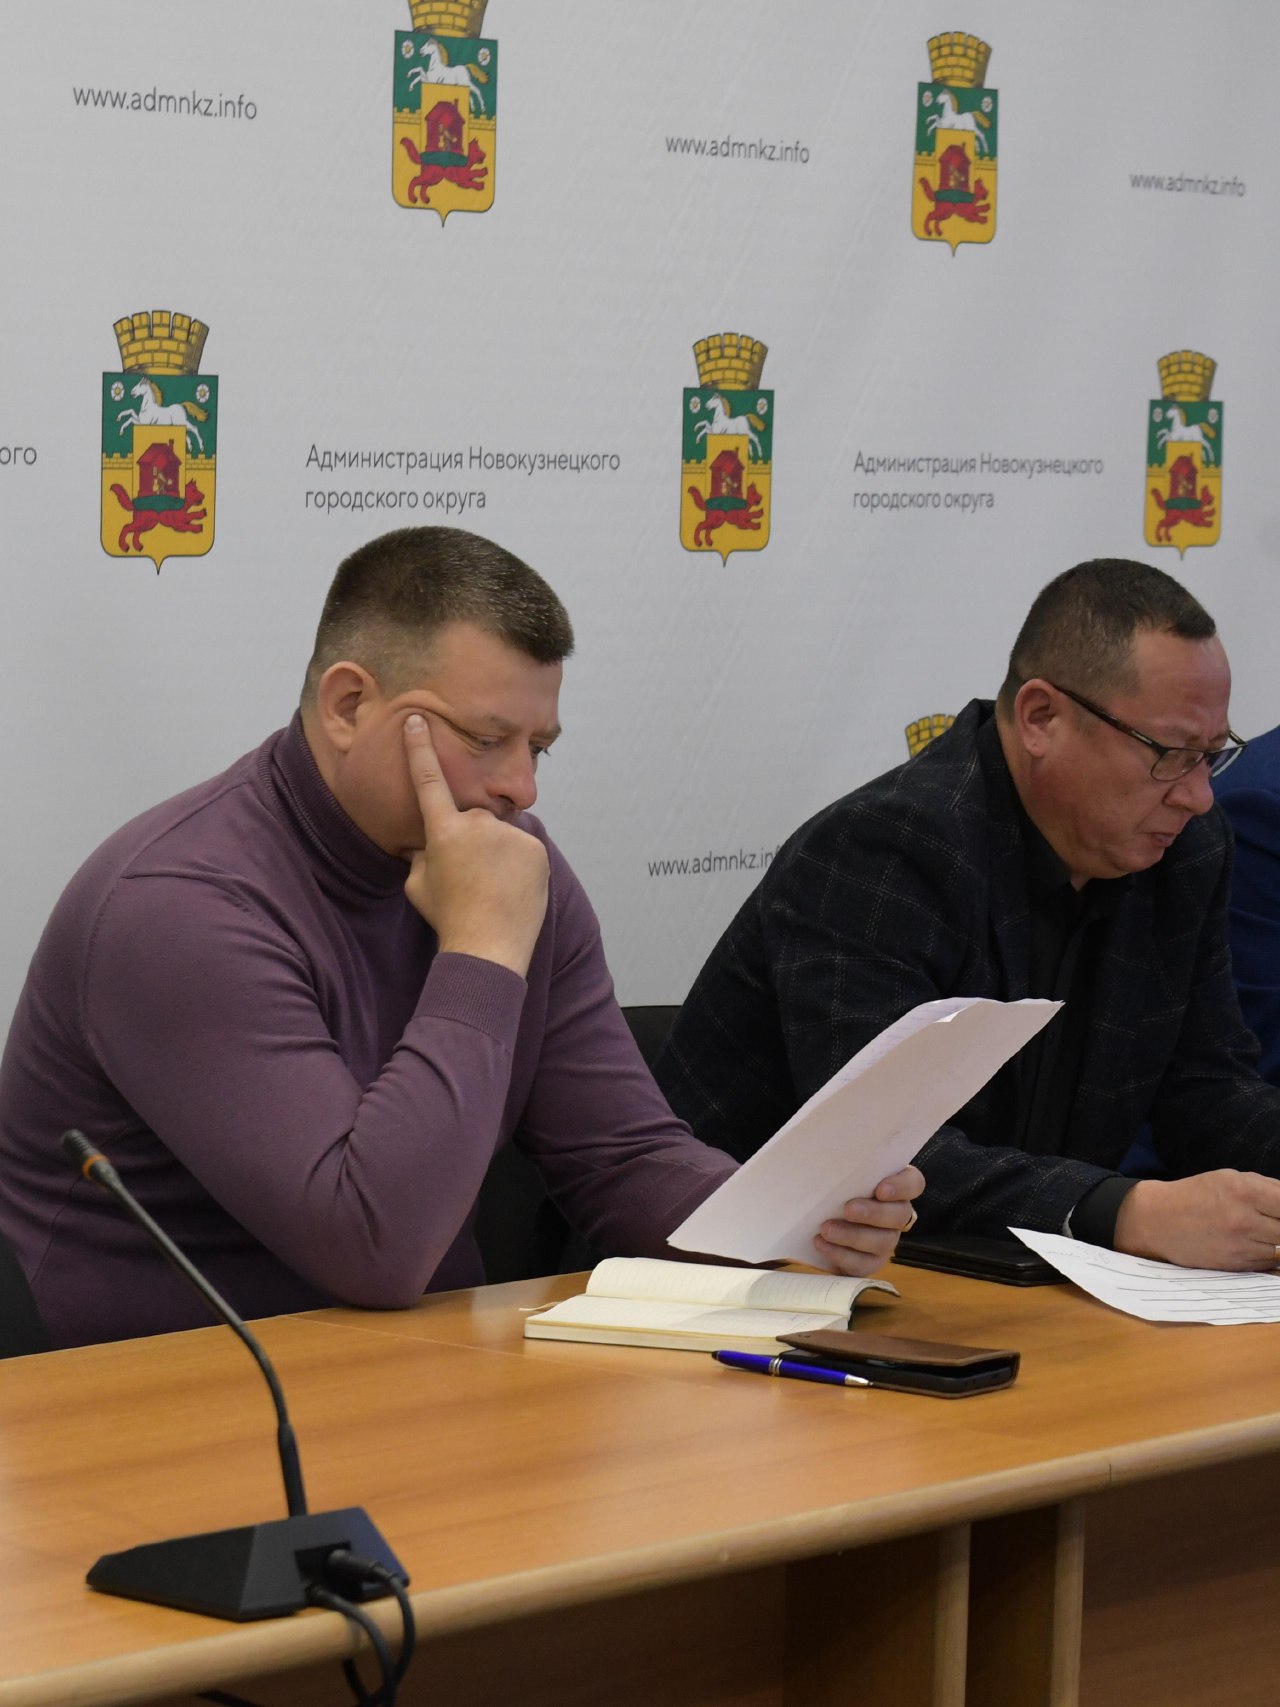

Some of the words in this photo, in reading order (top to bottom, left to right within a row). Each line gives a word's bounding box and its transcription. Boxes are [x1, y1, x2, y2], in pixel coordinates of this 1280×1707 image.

[72, 85, 258, 121] www.admnkz.info
[665, 135, 810, 164] www.admnkz.info
[1130, 173, 1246, 198] www.admnkz.info
[305, 443, 464, 475] Администрация
[468, 446, 621, 476] Новокузнецкого
[853, 449, 977, 478] Администрация
[980, 452, 1104, 479] Новокузнецкого
[305, 489, 420, 516] городского
[422, 490, 487, 516] округа
[853, 491, 942, 514] городского
[943, 493, 995, 514] округа
